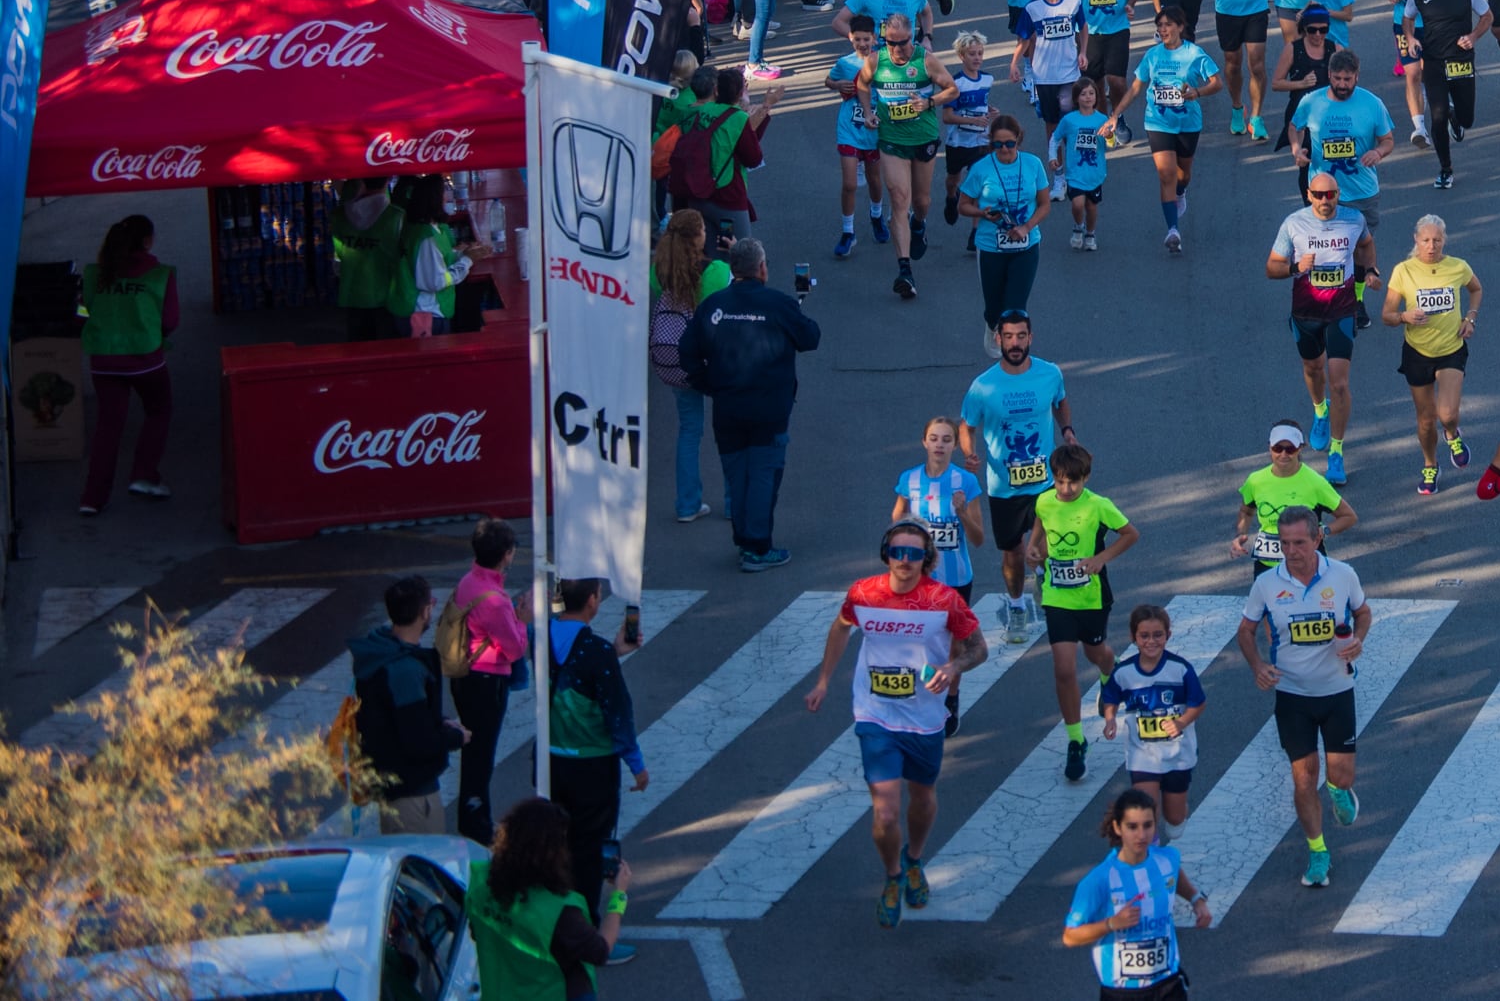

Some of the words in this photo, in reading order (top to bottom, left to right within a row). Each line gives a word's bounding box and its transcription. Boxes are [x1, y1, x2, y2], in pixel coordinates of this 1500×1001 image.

[1046, 24, 1070, 35] 2146
[165, 18, 388, 80] Coca-Cola
[1448, 62, 1472, 74] 1124
[883, 81, 917, 89] ATLETISMO
[1156, 90, 1181, 100] 2055
[890, 105, 915, 116] 1378
[365, 128, 475, 167] Coca-Cola
[1325, 144, 1353, 154] 1325
[92, 144, 207, 183] Coca-Cola
[1308, 238, 1349, 249] PINSAPO
[1312, 271, 1342, 282] 1031
[1420, 295, 1451, 307] 2008
[313, 409, 487, 475] Coca-Cola
[1011, 465, 1044, 480] 1035
[930, 529, 954, 542] 121
[1255, 539, 1280, 554] 213
[1053, 566, 1086, 580] 2189
[864, 620, 925, 635] CUSP25
[1293, 623, 1331, 638] 1165
[872, 675, 912, 690] 1438
[1124, 949, 1167, 968] 2885
